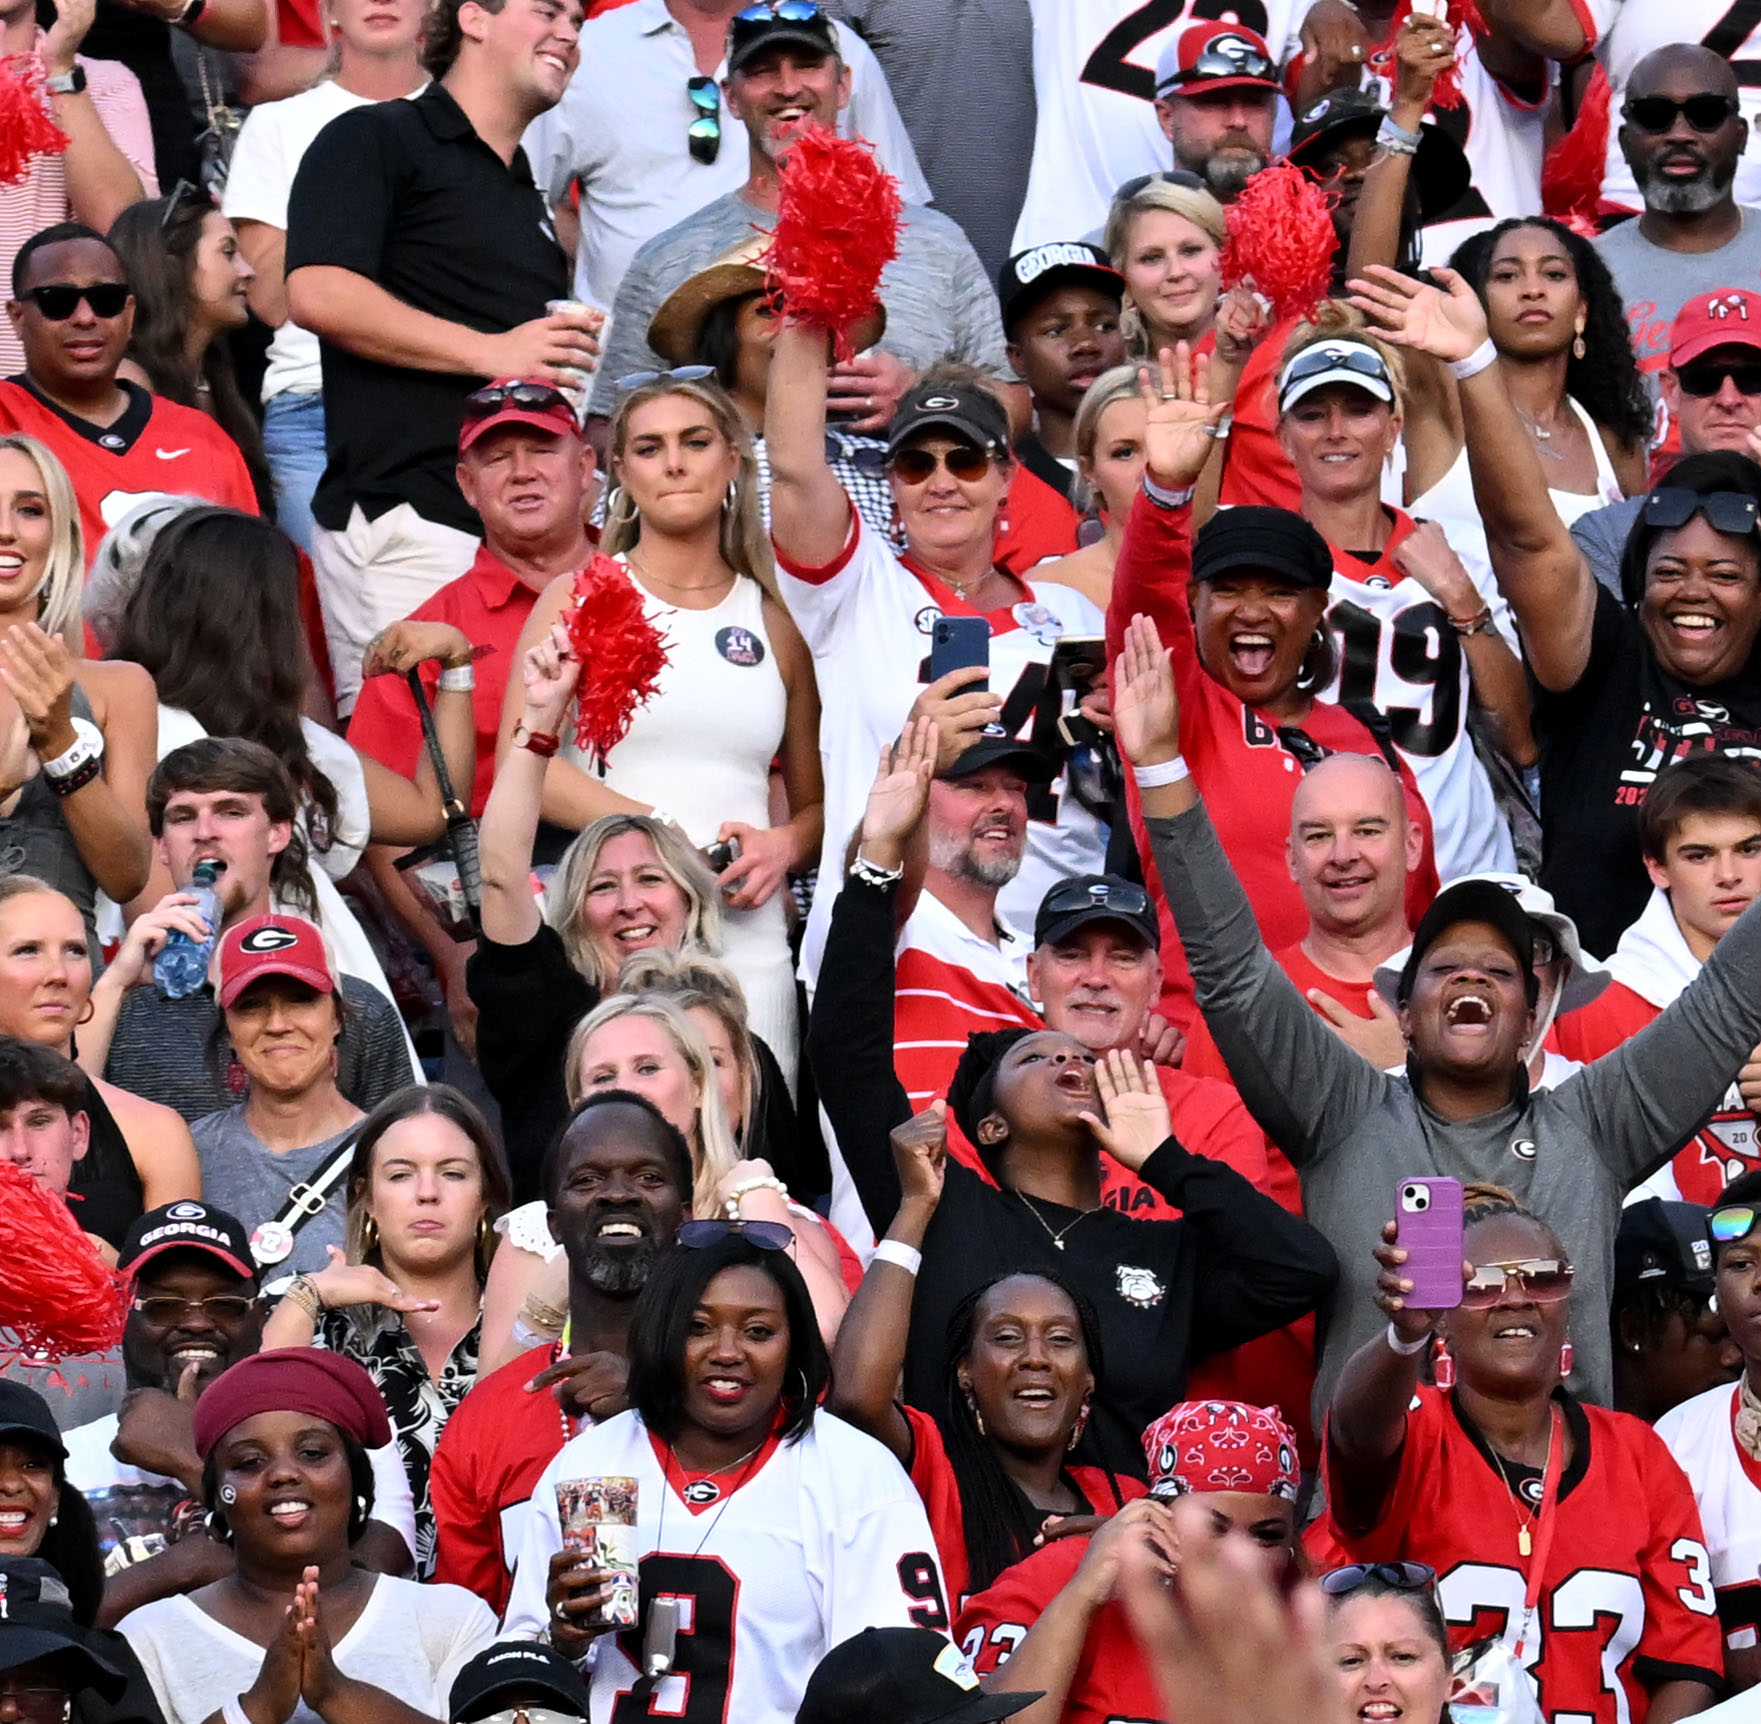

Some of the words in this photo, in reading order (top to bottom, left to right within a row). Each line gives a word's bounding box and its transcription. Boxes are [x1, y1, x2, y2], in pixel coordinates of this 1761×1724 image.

[1015, 243, 1097, 283] GEORGIA
[920, 396, 957, 410] G
[244, 927, 298, 951] G
[1733, 1132, 1747, 1144] 20
[170, 1204, 206, 1219] G
[140, 1223, 231, 1247] GEORGIA
[684, 1482, 719, 1503] G
[1671, 1538, 1716, 1615] 3
